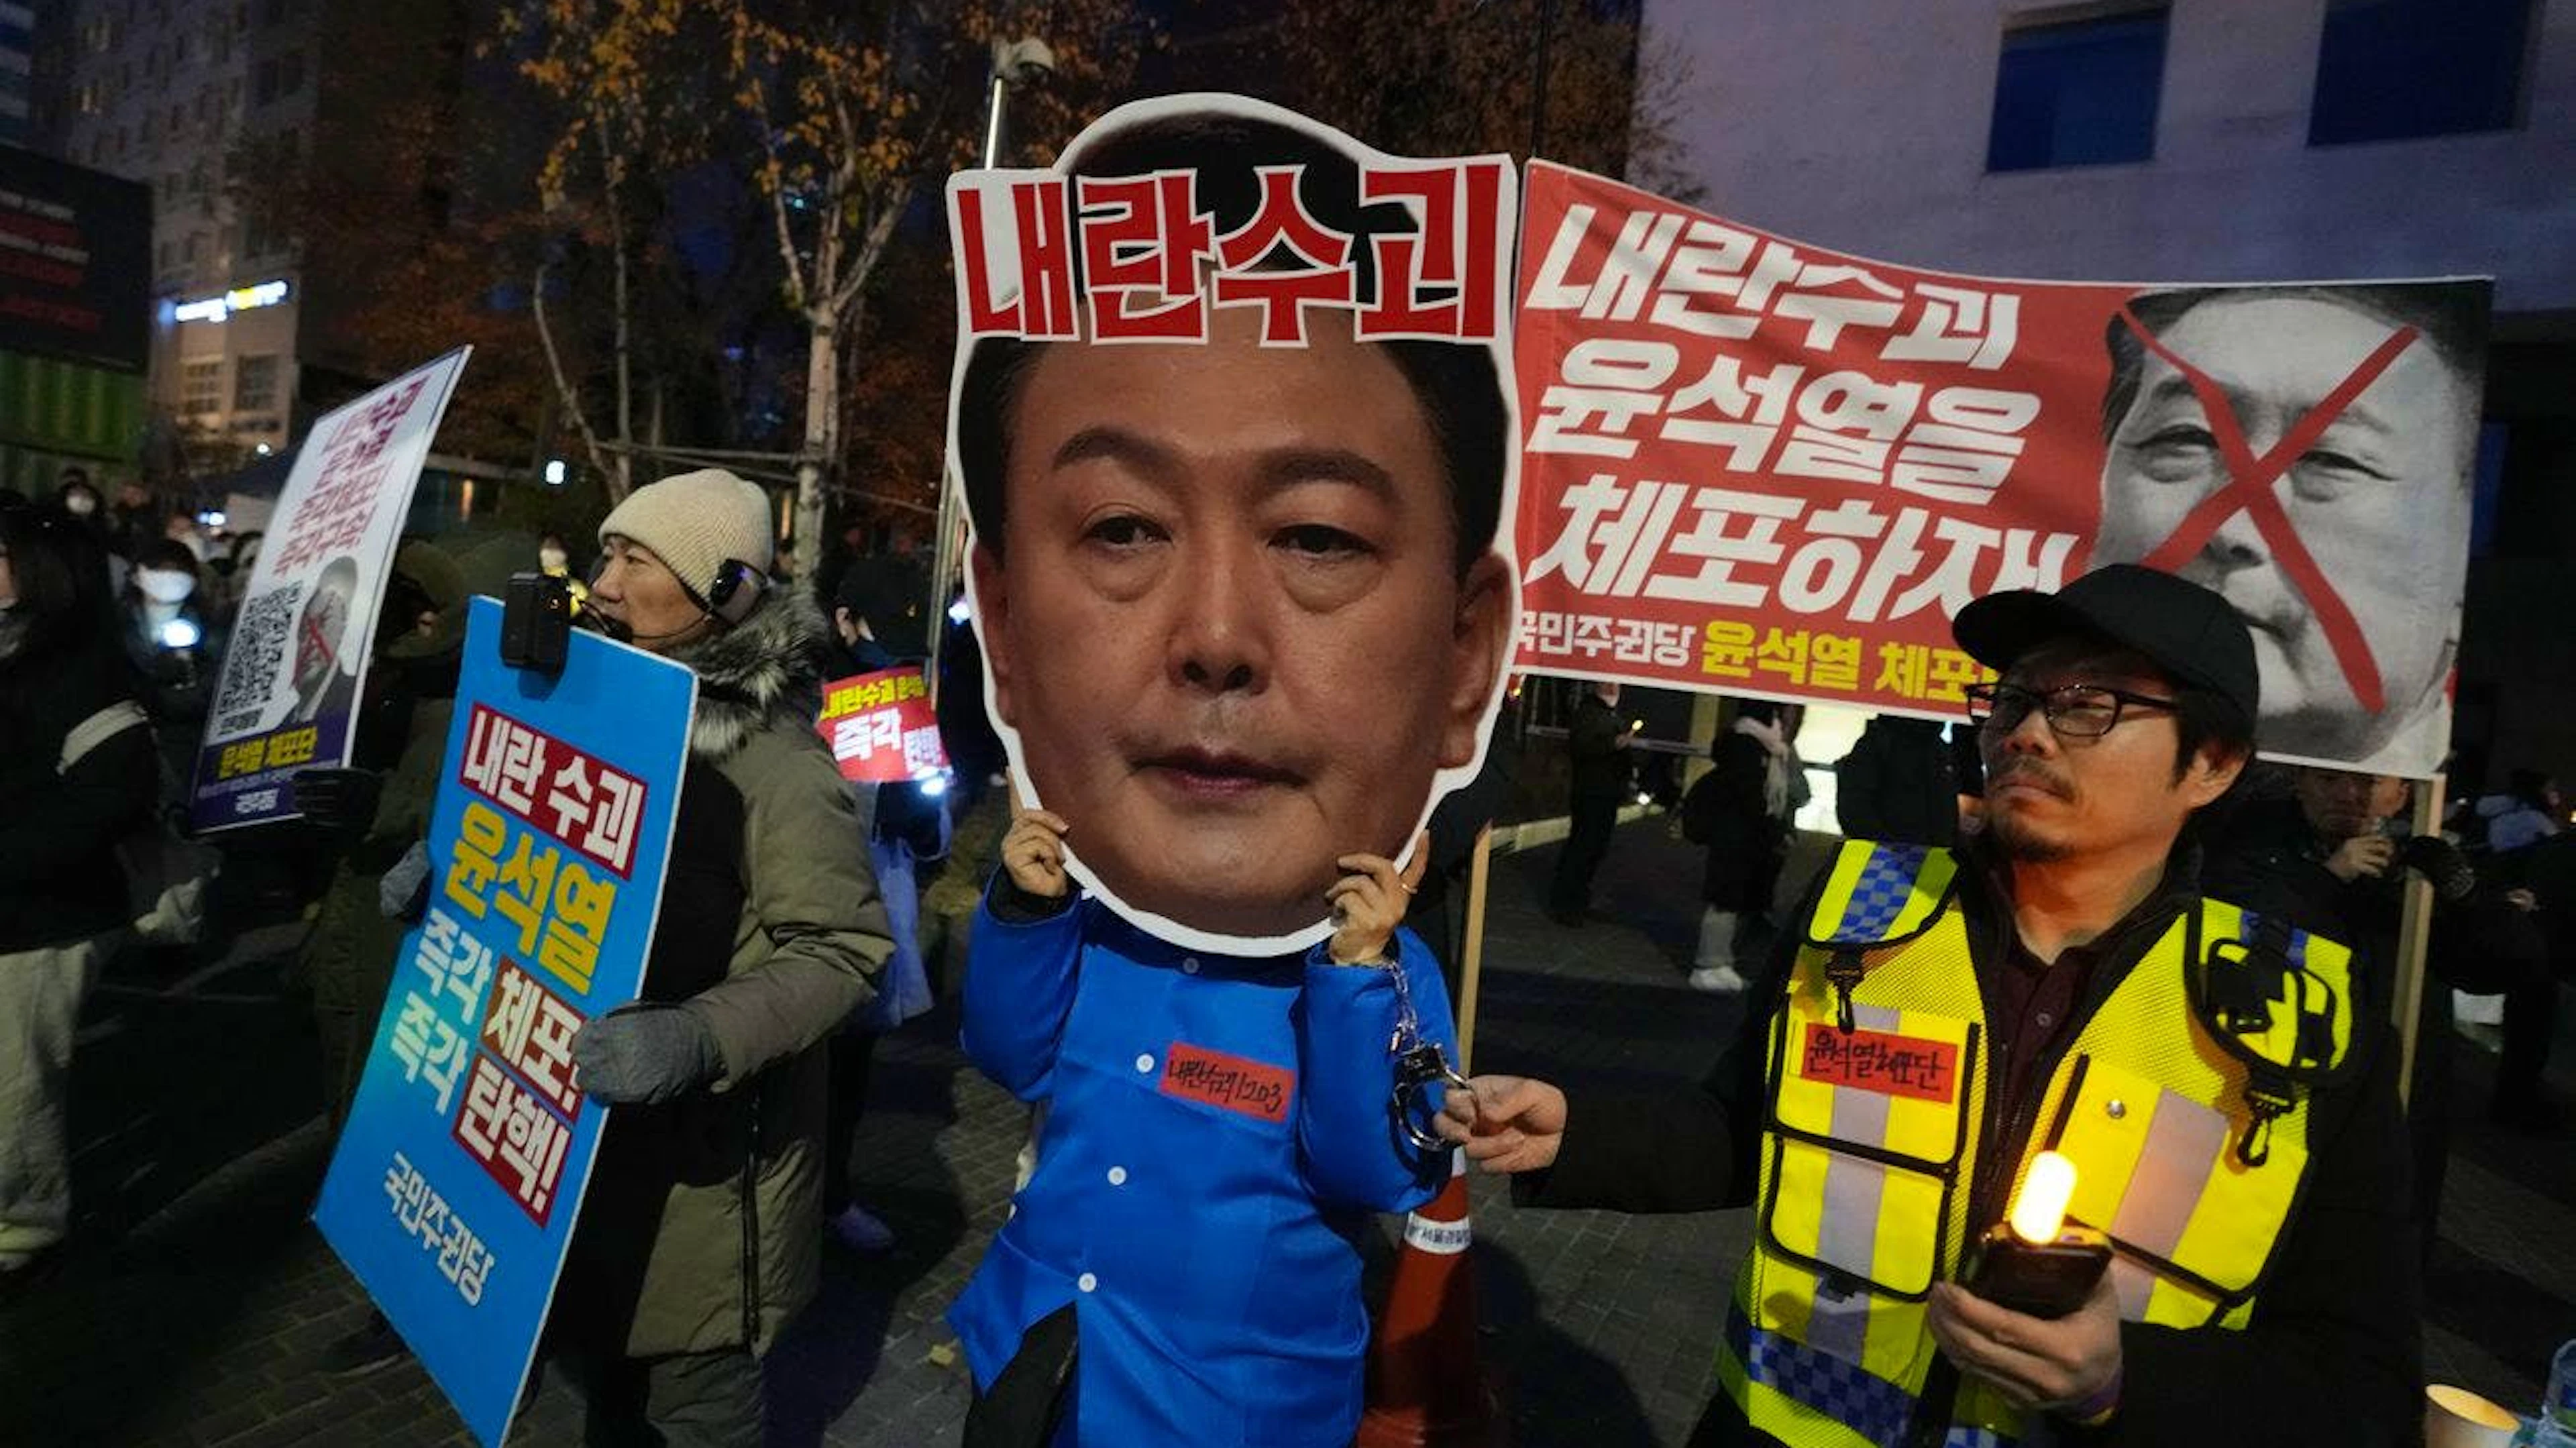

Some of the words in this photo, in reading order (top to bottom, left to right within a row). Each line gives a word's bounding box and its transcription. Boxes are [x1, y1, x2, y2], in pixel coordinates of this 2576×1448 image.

[955, 163, 1503, 343] 내란수괴
[1525, 203, 2021, 370] 내란수괴
[1525, 339, 2041, 505] 윤석열을
[833, 708, 902, 762] 즉각
[1701, 620, 1863, 691] 윤석열
[1873, 641, 1998, 703] 체포
[464, 710, 546, 816] 내란
[547, 756, 645, 871] 수괴
[415, 907, 492, 1025] 즉각
[444, 801, 616, 996] 윤석열
[390, 991, 468, 1116] 즉각
[459, 1056, 572, 1213] 탄핵!
[383, 1151, 495, 1306] 국민주권당
